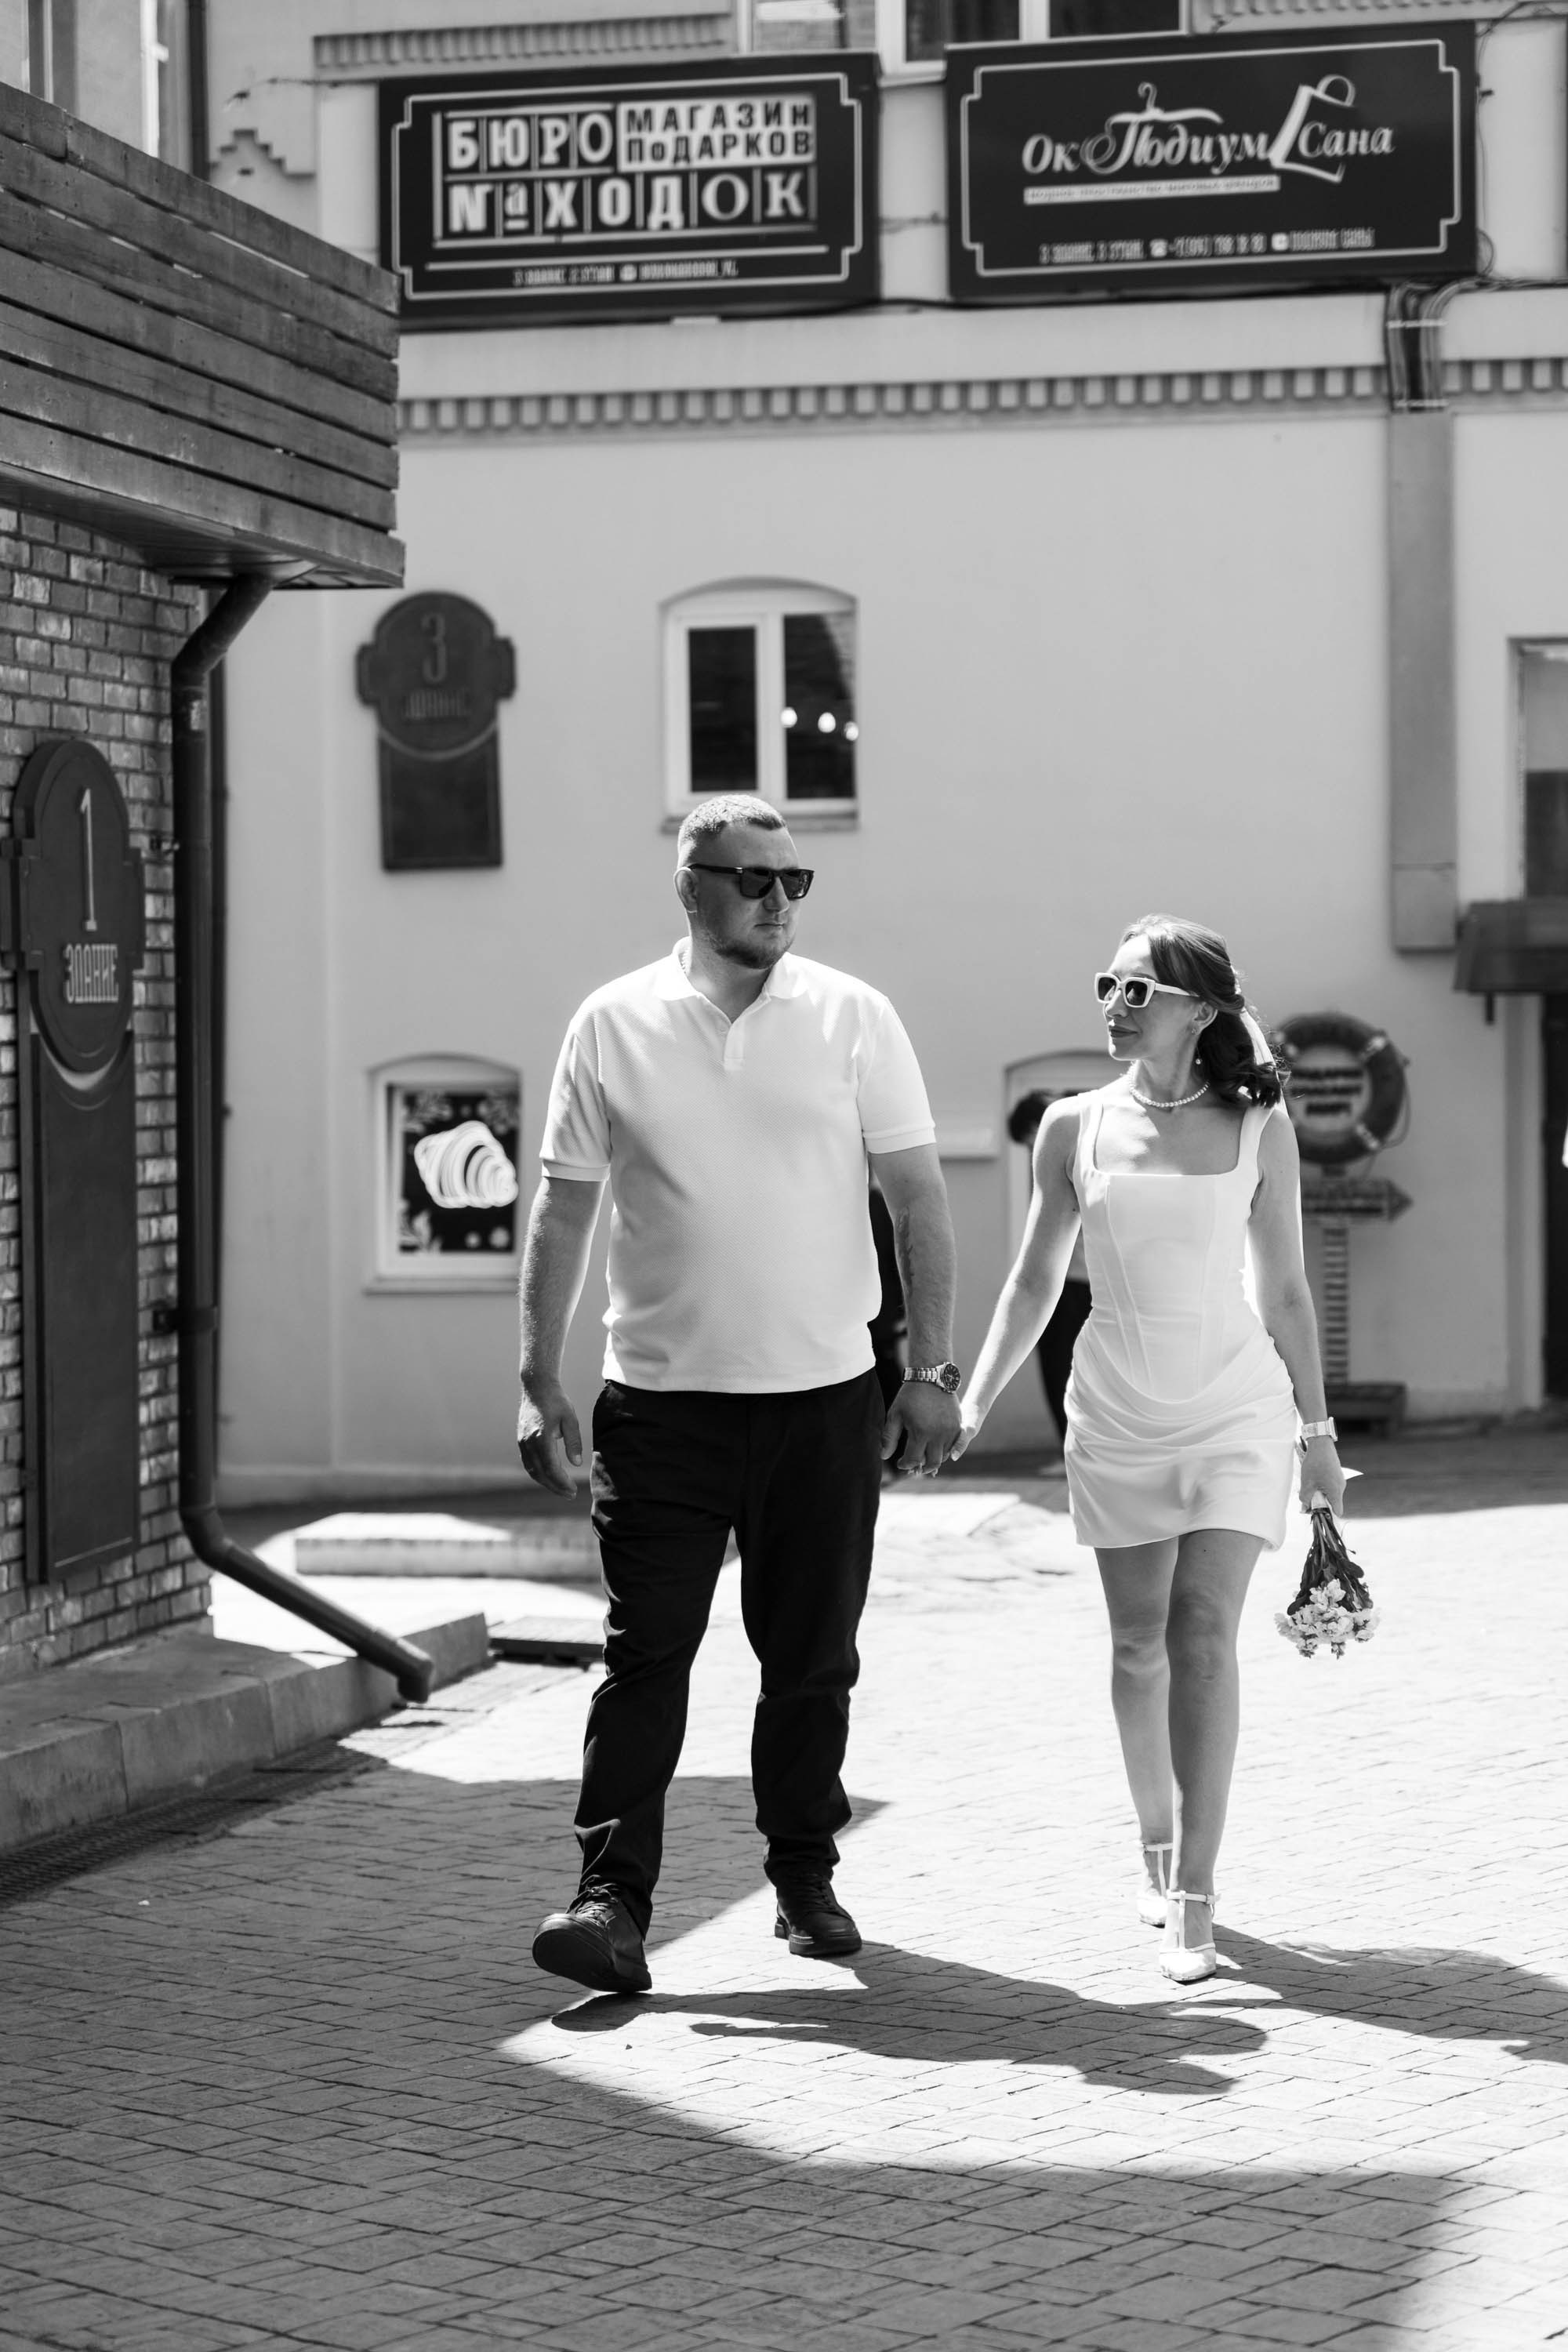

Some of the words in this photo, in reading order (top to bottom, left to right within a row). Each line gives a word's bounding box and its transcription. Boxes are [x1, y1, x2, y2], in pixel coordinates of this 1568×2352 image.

[448, 112, 614, 170] БЮРО
[627, 101, 809, 134] МАГАЗИН
[1022, 132, 1080, 175] Ок
[66, 943, 119, 1004] ЗДАНИЕ
